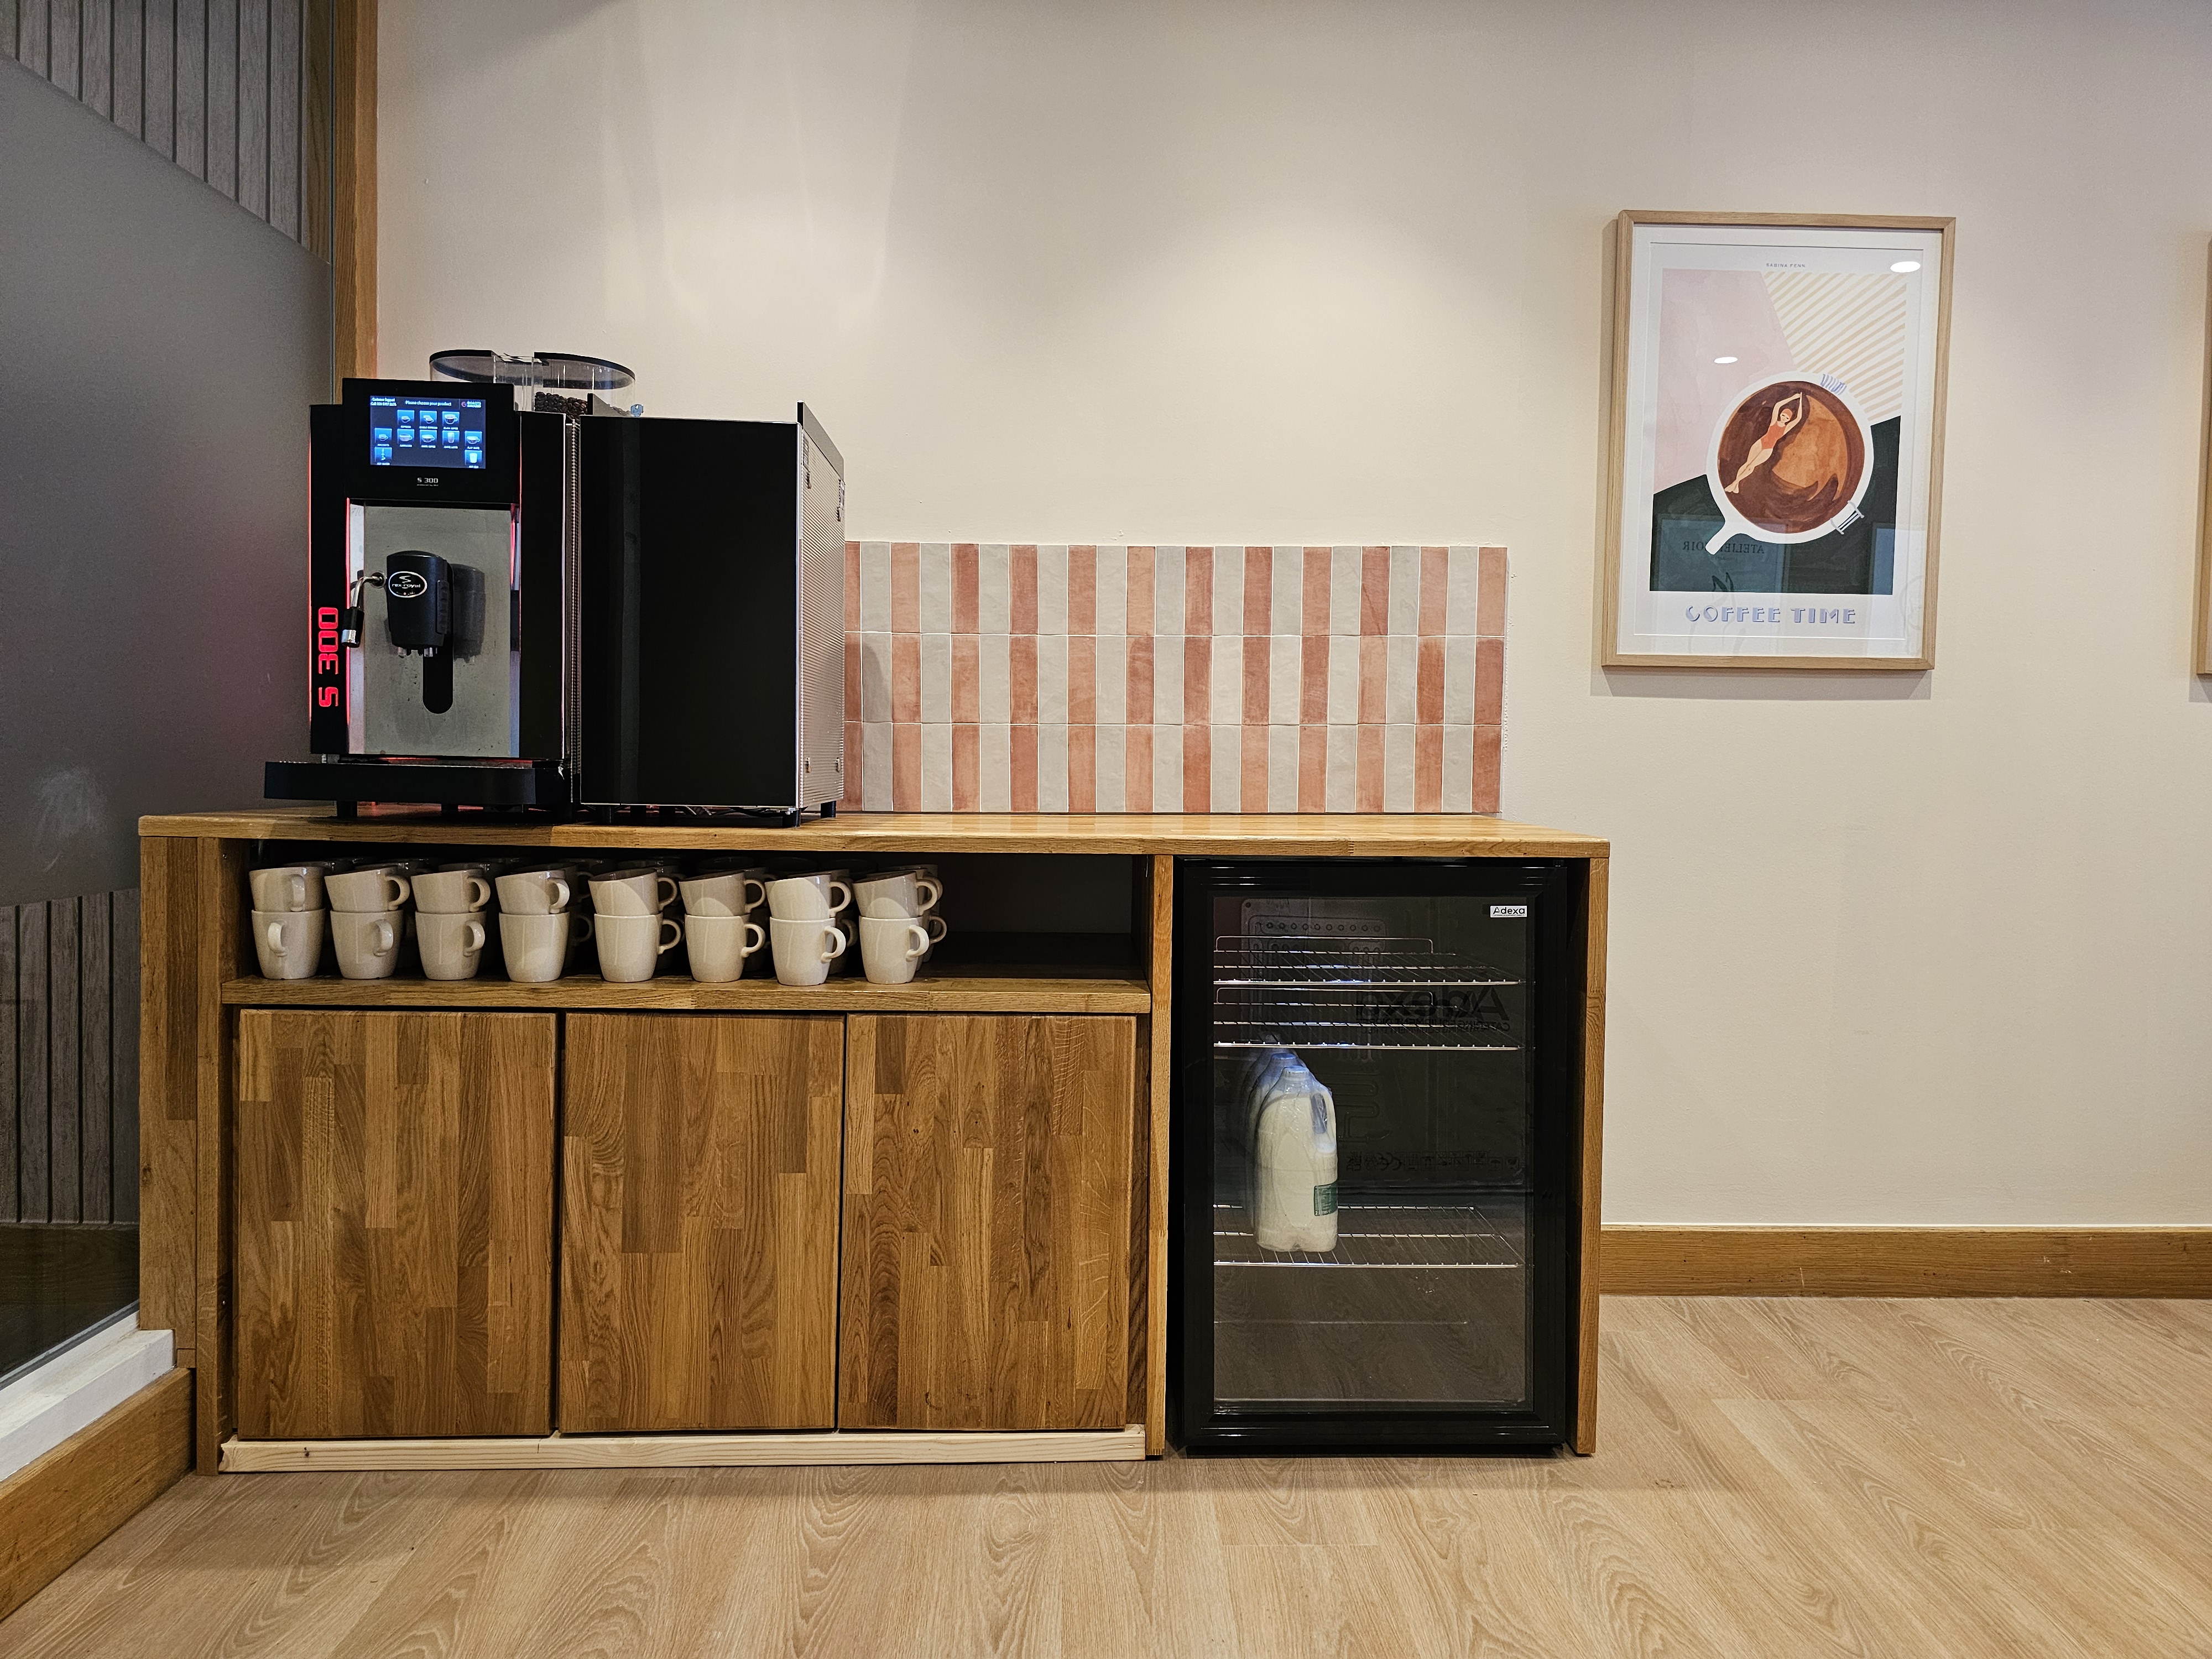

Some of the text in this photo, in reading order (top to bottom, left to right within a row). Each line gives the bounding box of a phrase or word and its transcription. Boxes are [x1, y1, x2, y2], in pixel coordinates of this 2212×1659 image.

[1686, 606, 1855, 624] COFFEE TIME
[318, 607, 339, 707] S 300
[1493, 906, 1525, 915] Adexa
